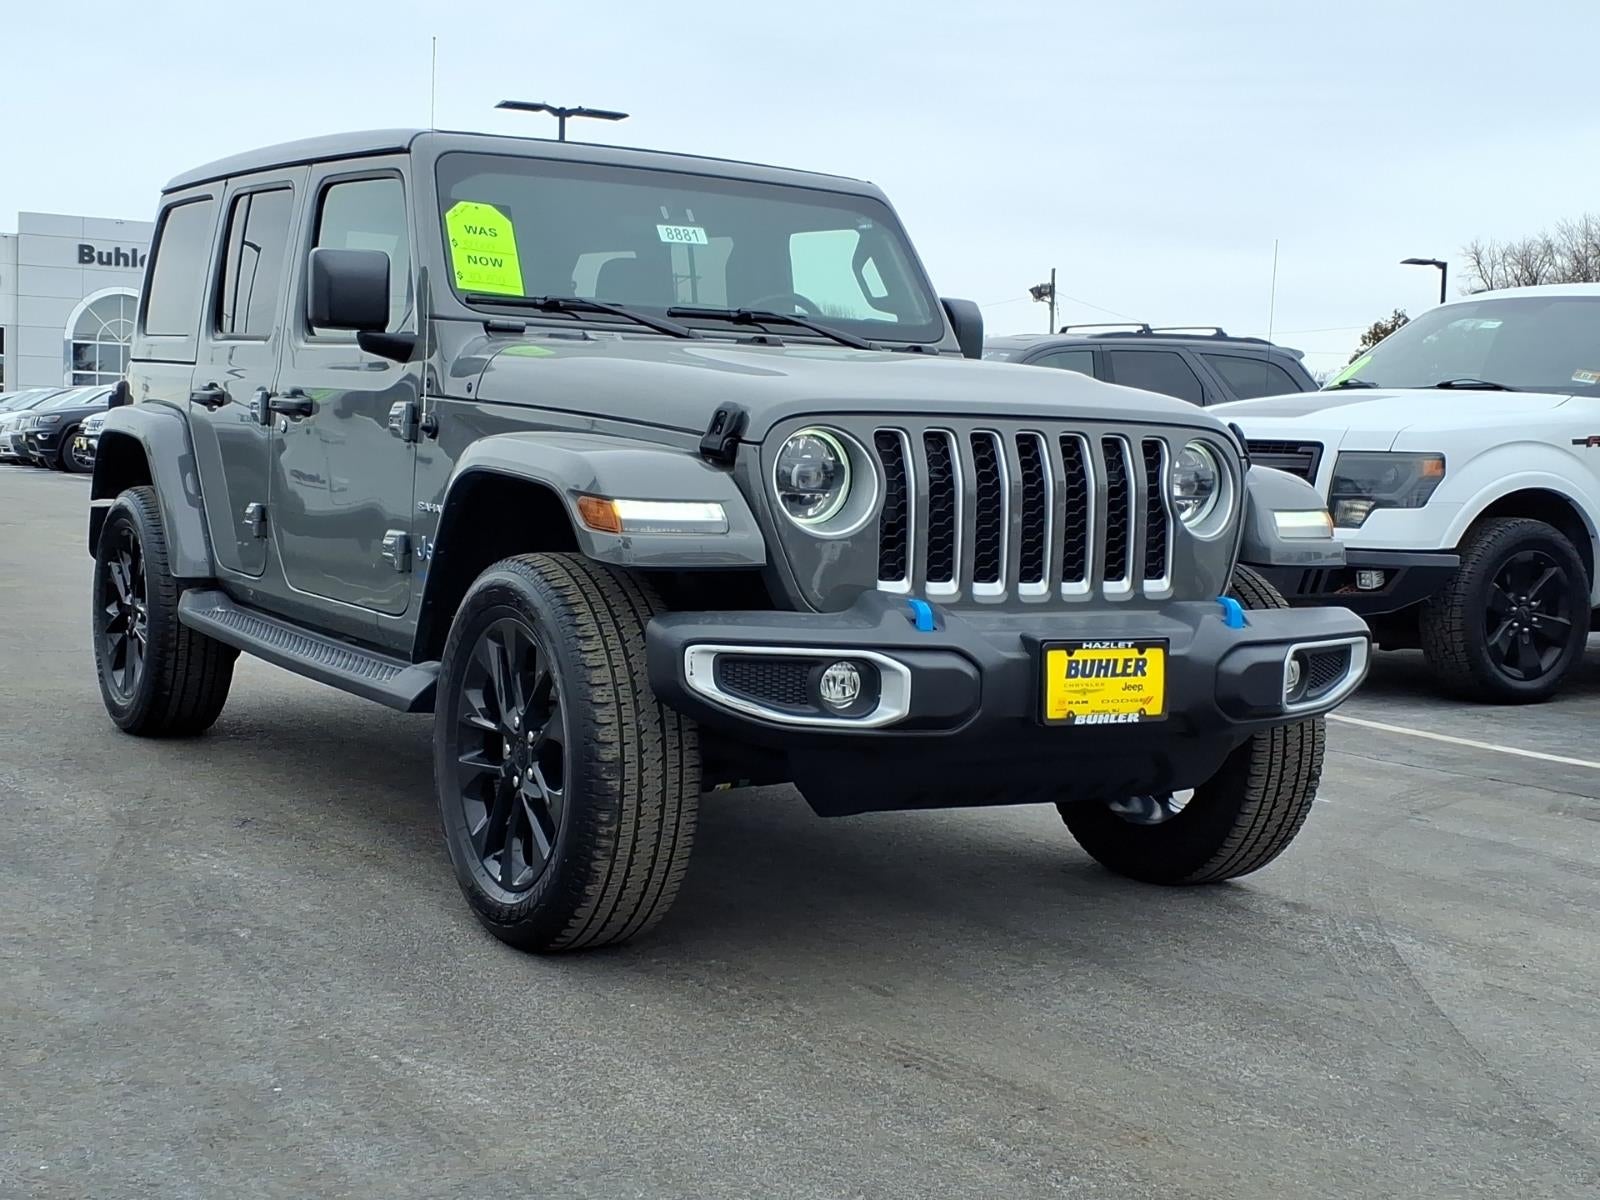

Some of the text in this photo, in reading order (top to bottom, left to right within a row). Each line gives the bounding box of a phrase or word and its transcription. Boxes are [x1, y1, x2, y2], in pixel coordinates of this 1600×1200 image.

[464, 224, 498, 238] WAS
[665, 227, 699, 242] 8881
[467, 254, 503, 268] NOW
[1082, 641, 1135, 649] HAZLET
[1065, 657, 1148, 679] BUHLER
[1121, 682, 1144, 692] Jeep
[1074, 712, 1140, 725] BUHLER
